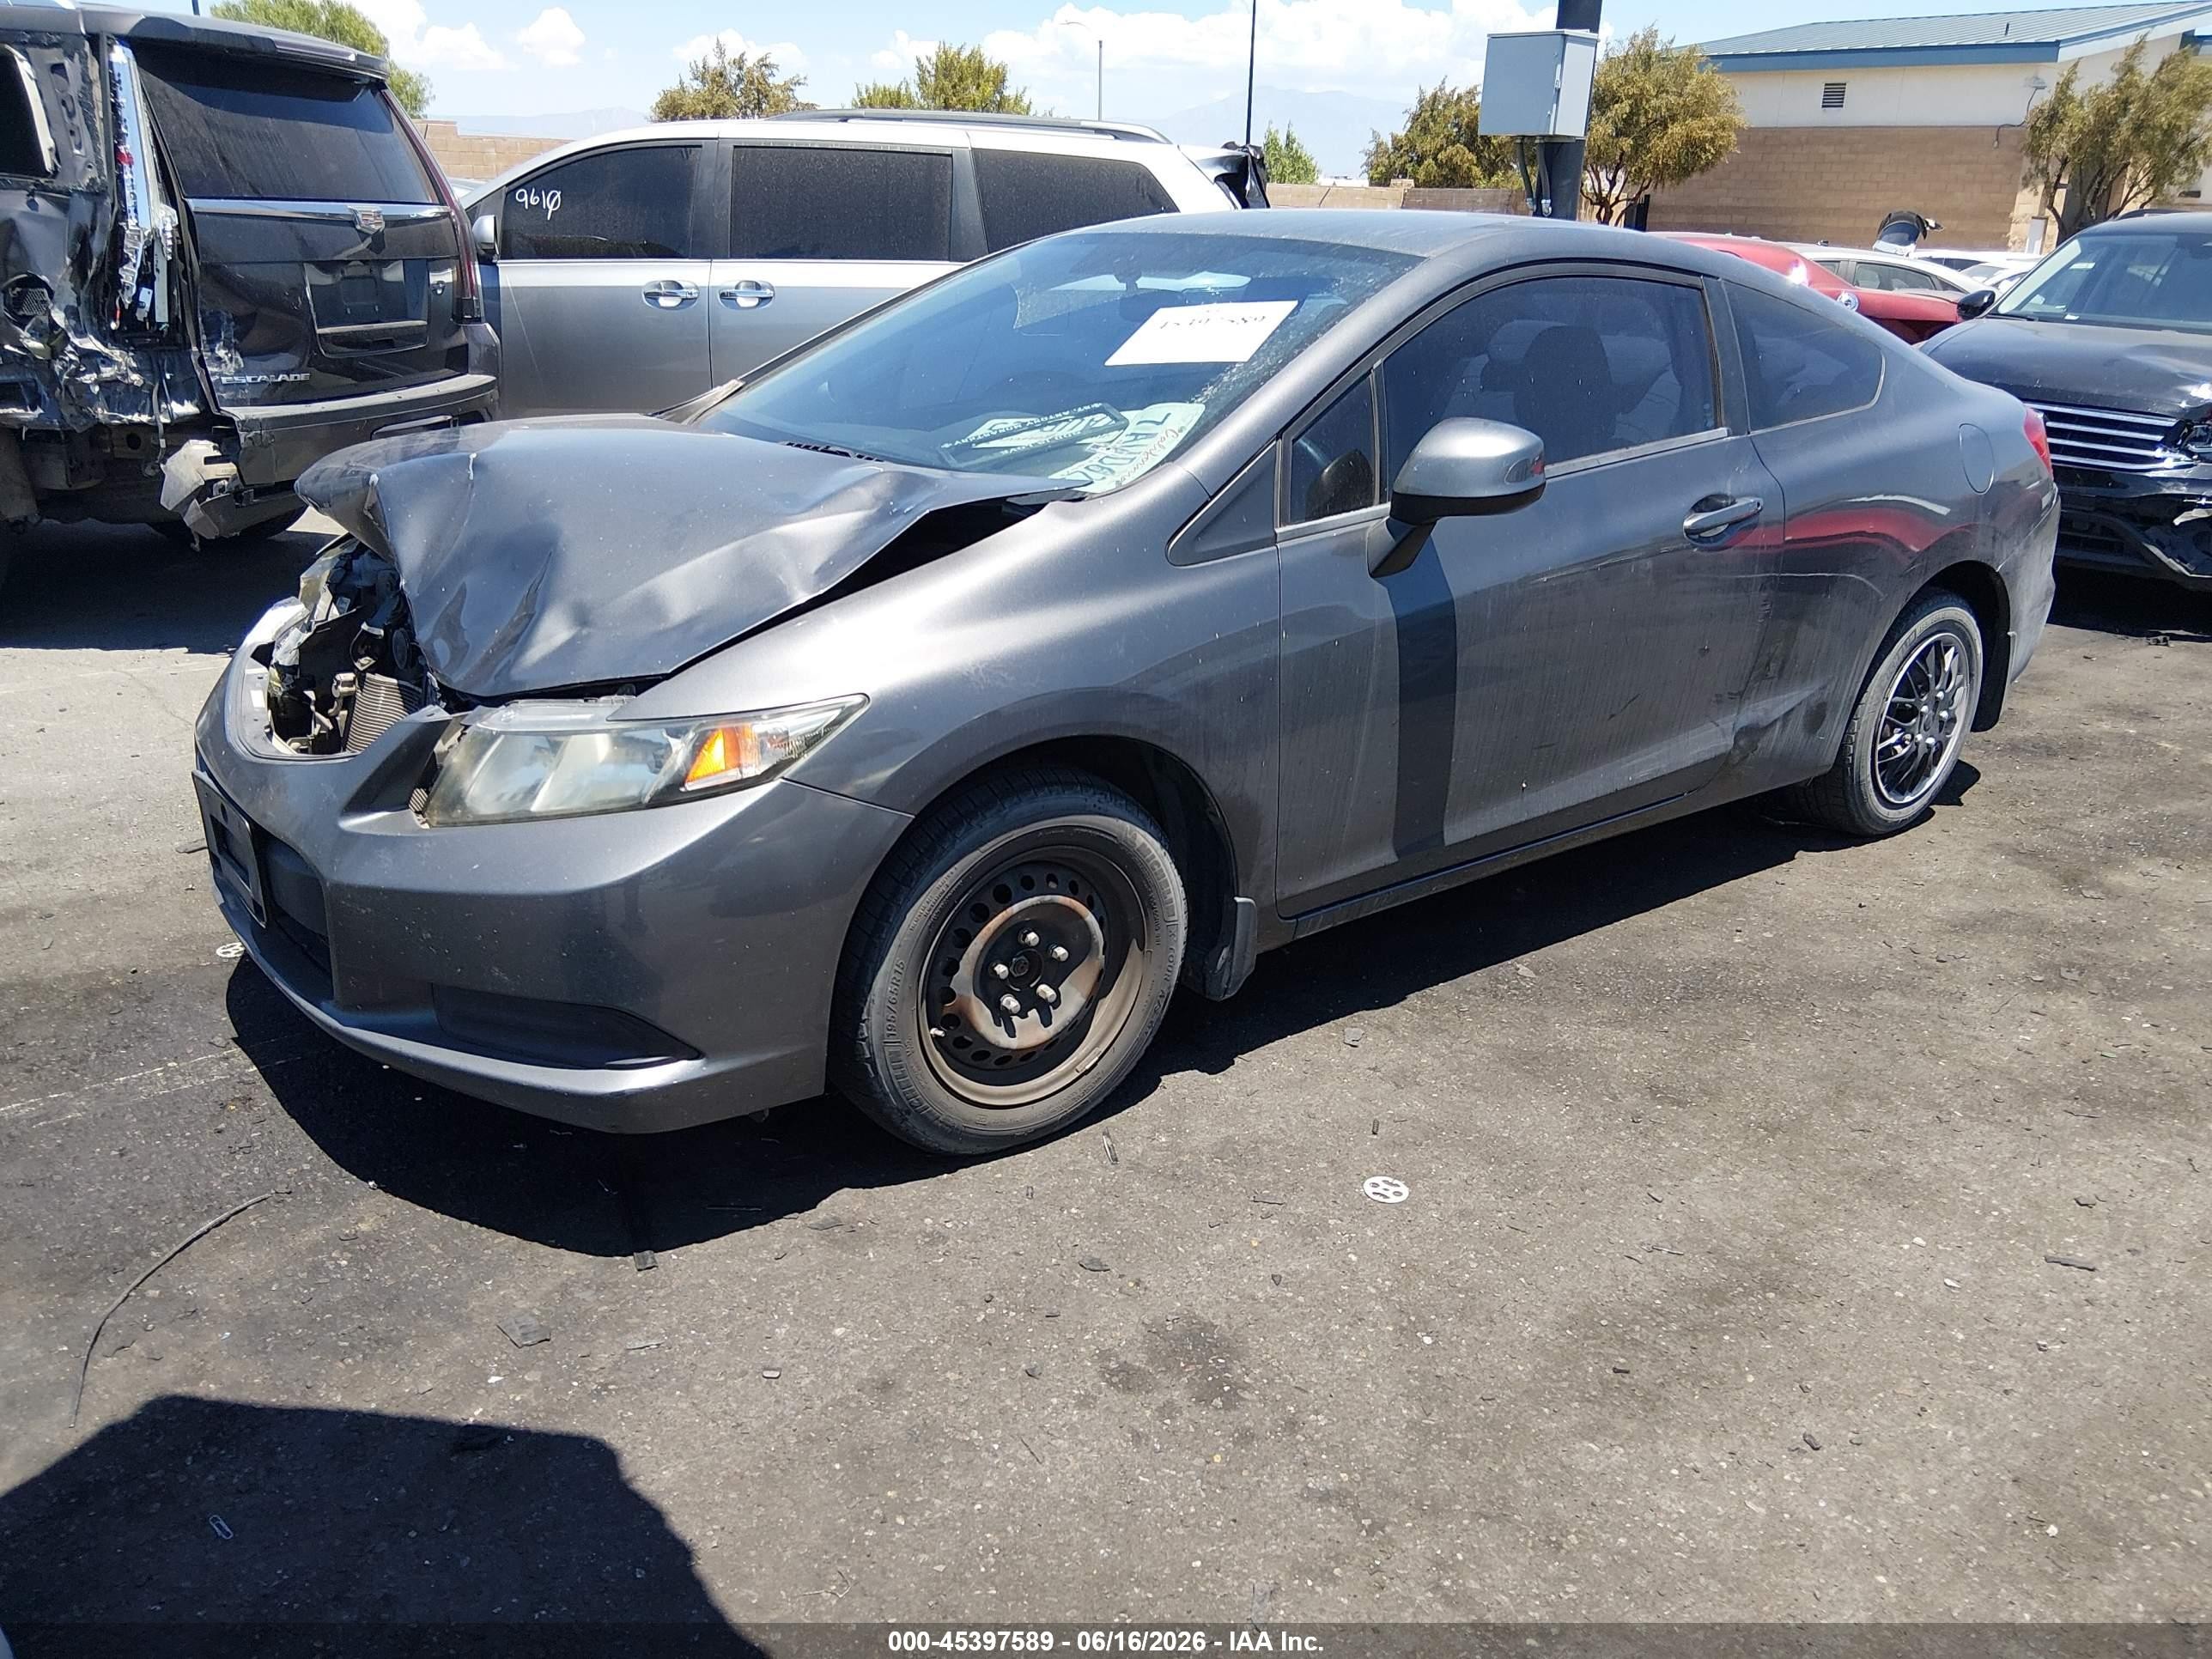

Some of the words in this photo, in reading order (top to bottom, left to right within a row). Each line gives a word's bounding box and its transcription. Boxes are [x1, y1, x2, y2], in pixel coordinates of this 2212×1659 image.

[220, 373, 311, 385] ESCALADE
[1119, 428, 1180, 483] California
[1164, 946, 1176, 982] TOUR
[885, 960, 906, 1038] 195/65R15
